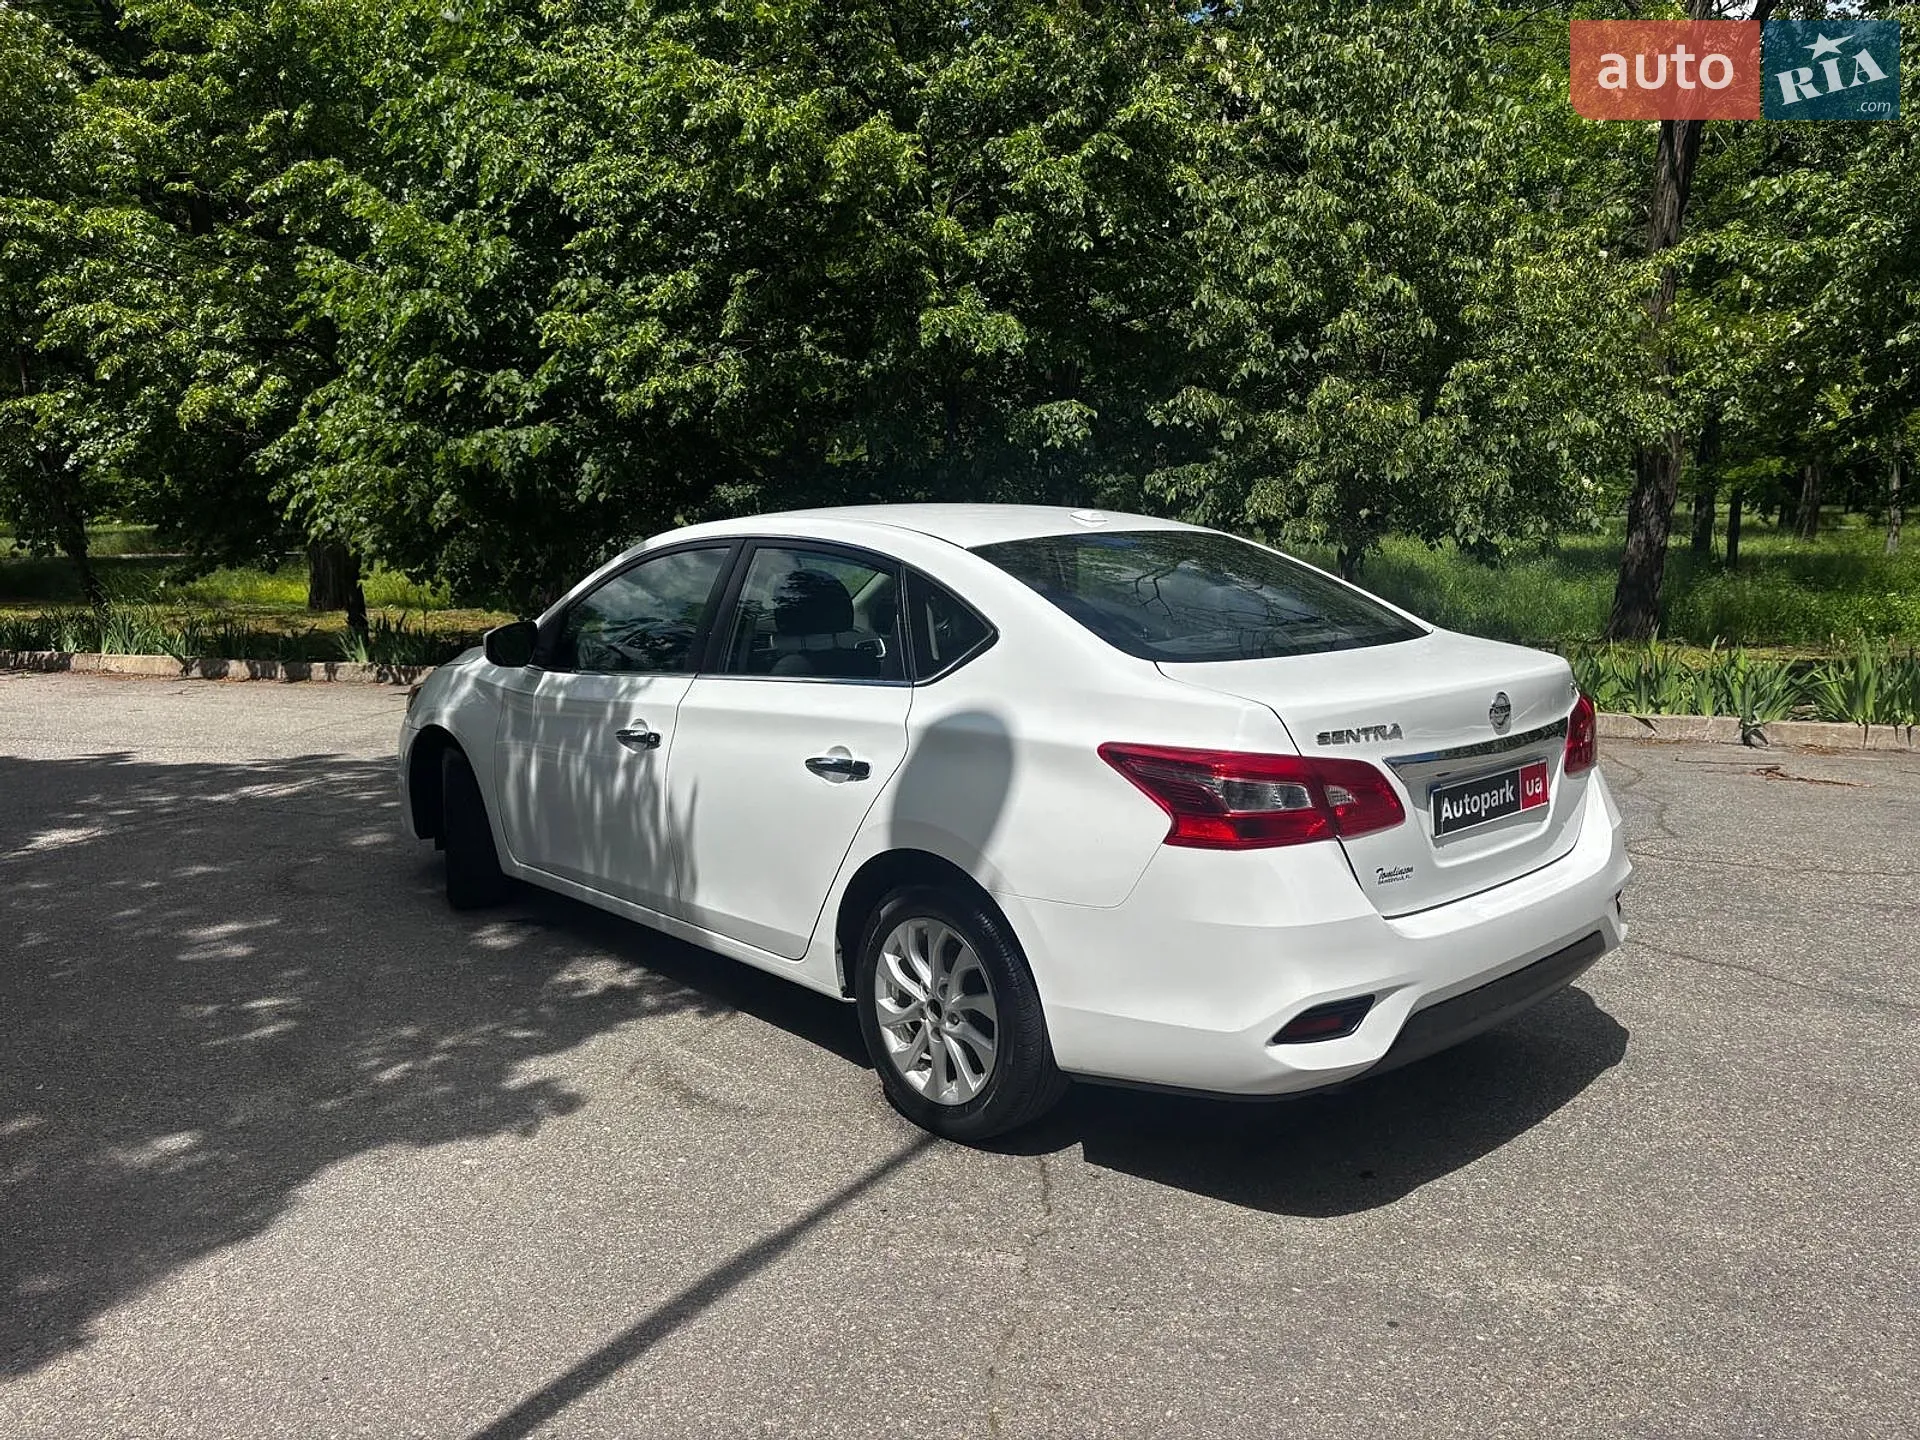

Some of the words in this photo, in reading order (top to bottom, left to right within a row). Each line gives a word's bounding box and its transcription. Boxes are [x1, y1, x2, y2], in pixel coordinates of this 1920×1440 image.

[1316, 723, 1404, 746] SENTRA
[1440, 779, 1515, 822] Autopark
[1525, 776, 1543, 797] ua
